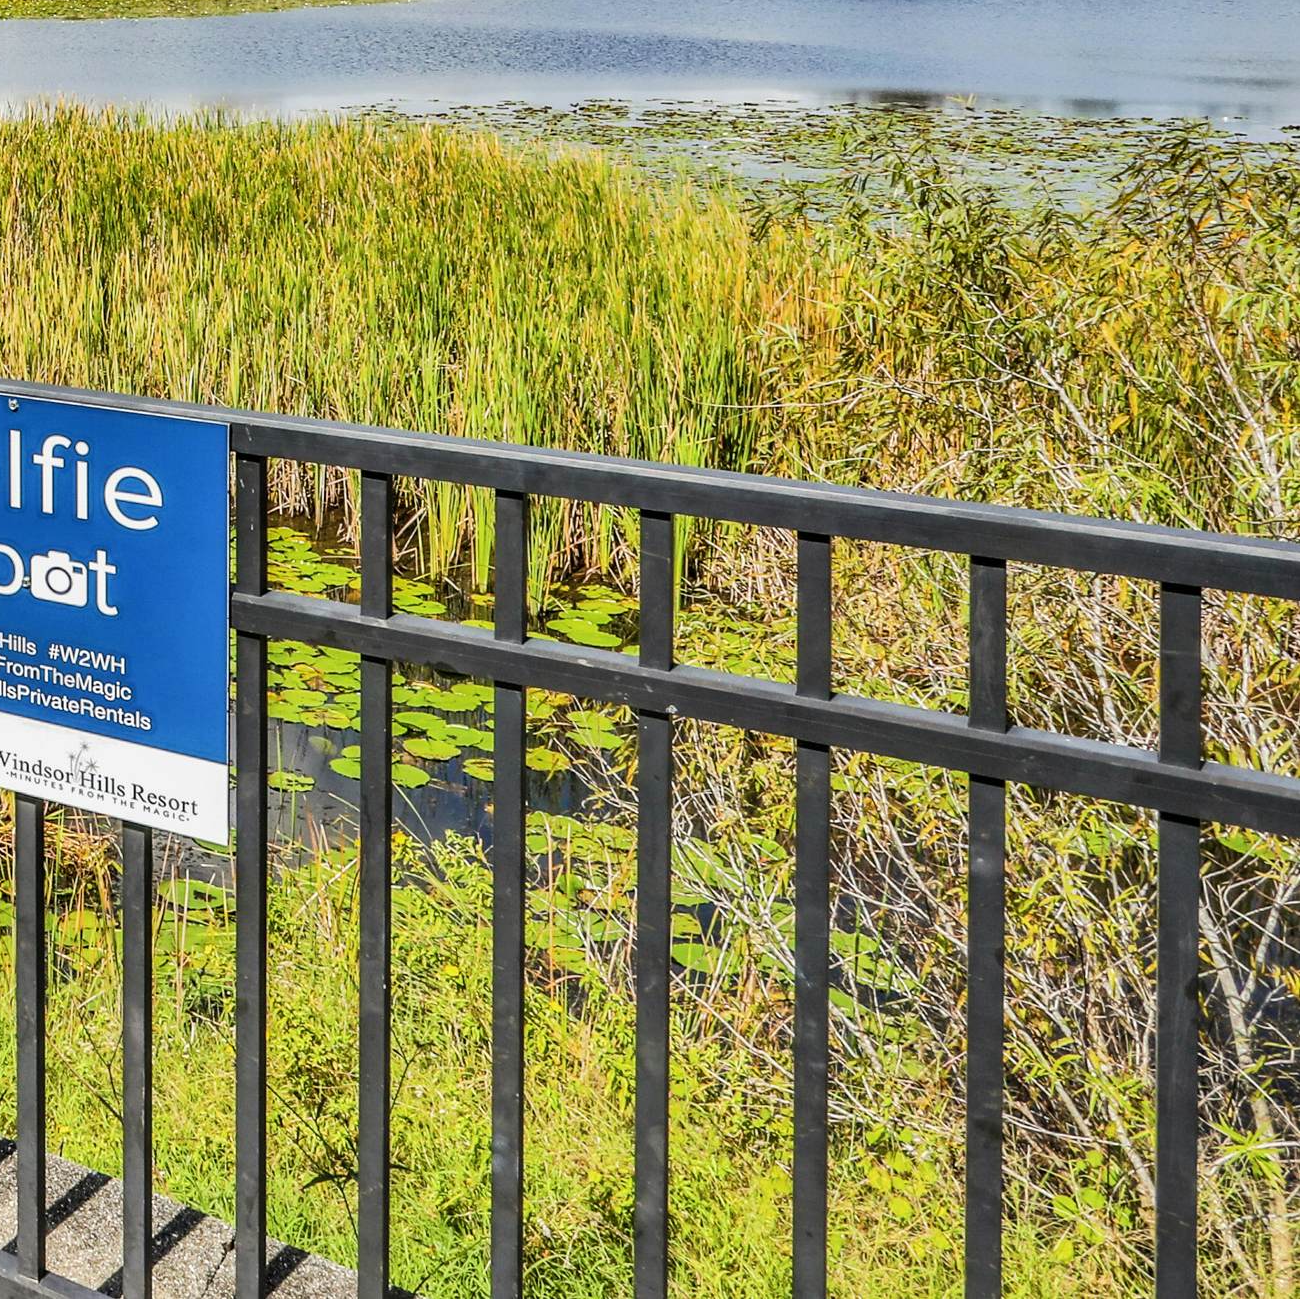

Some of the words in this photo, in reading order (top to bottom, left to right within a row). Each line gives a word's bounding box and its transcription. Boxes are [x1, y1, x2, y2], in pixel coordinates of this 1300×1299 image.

[48, 644, 126, 675] #W2WH
[71, 786, 105, 801] FROM
[112, 796, 136, 810] THE
[80, 770, 126, 797] Hills
[131, 783, 200, 816] Resort
